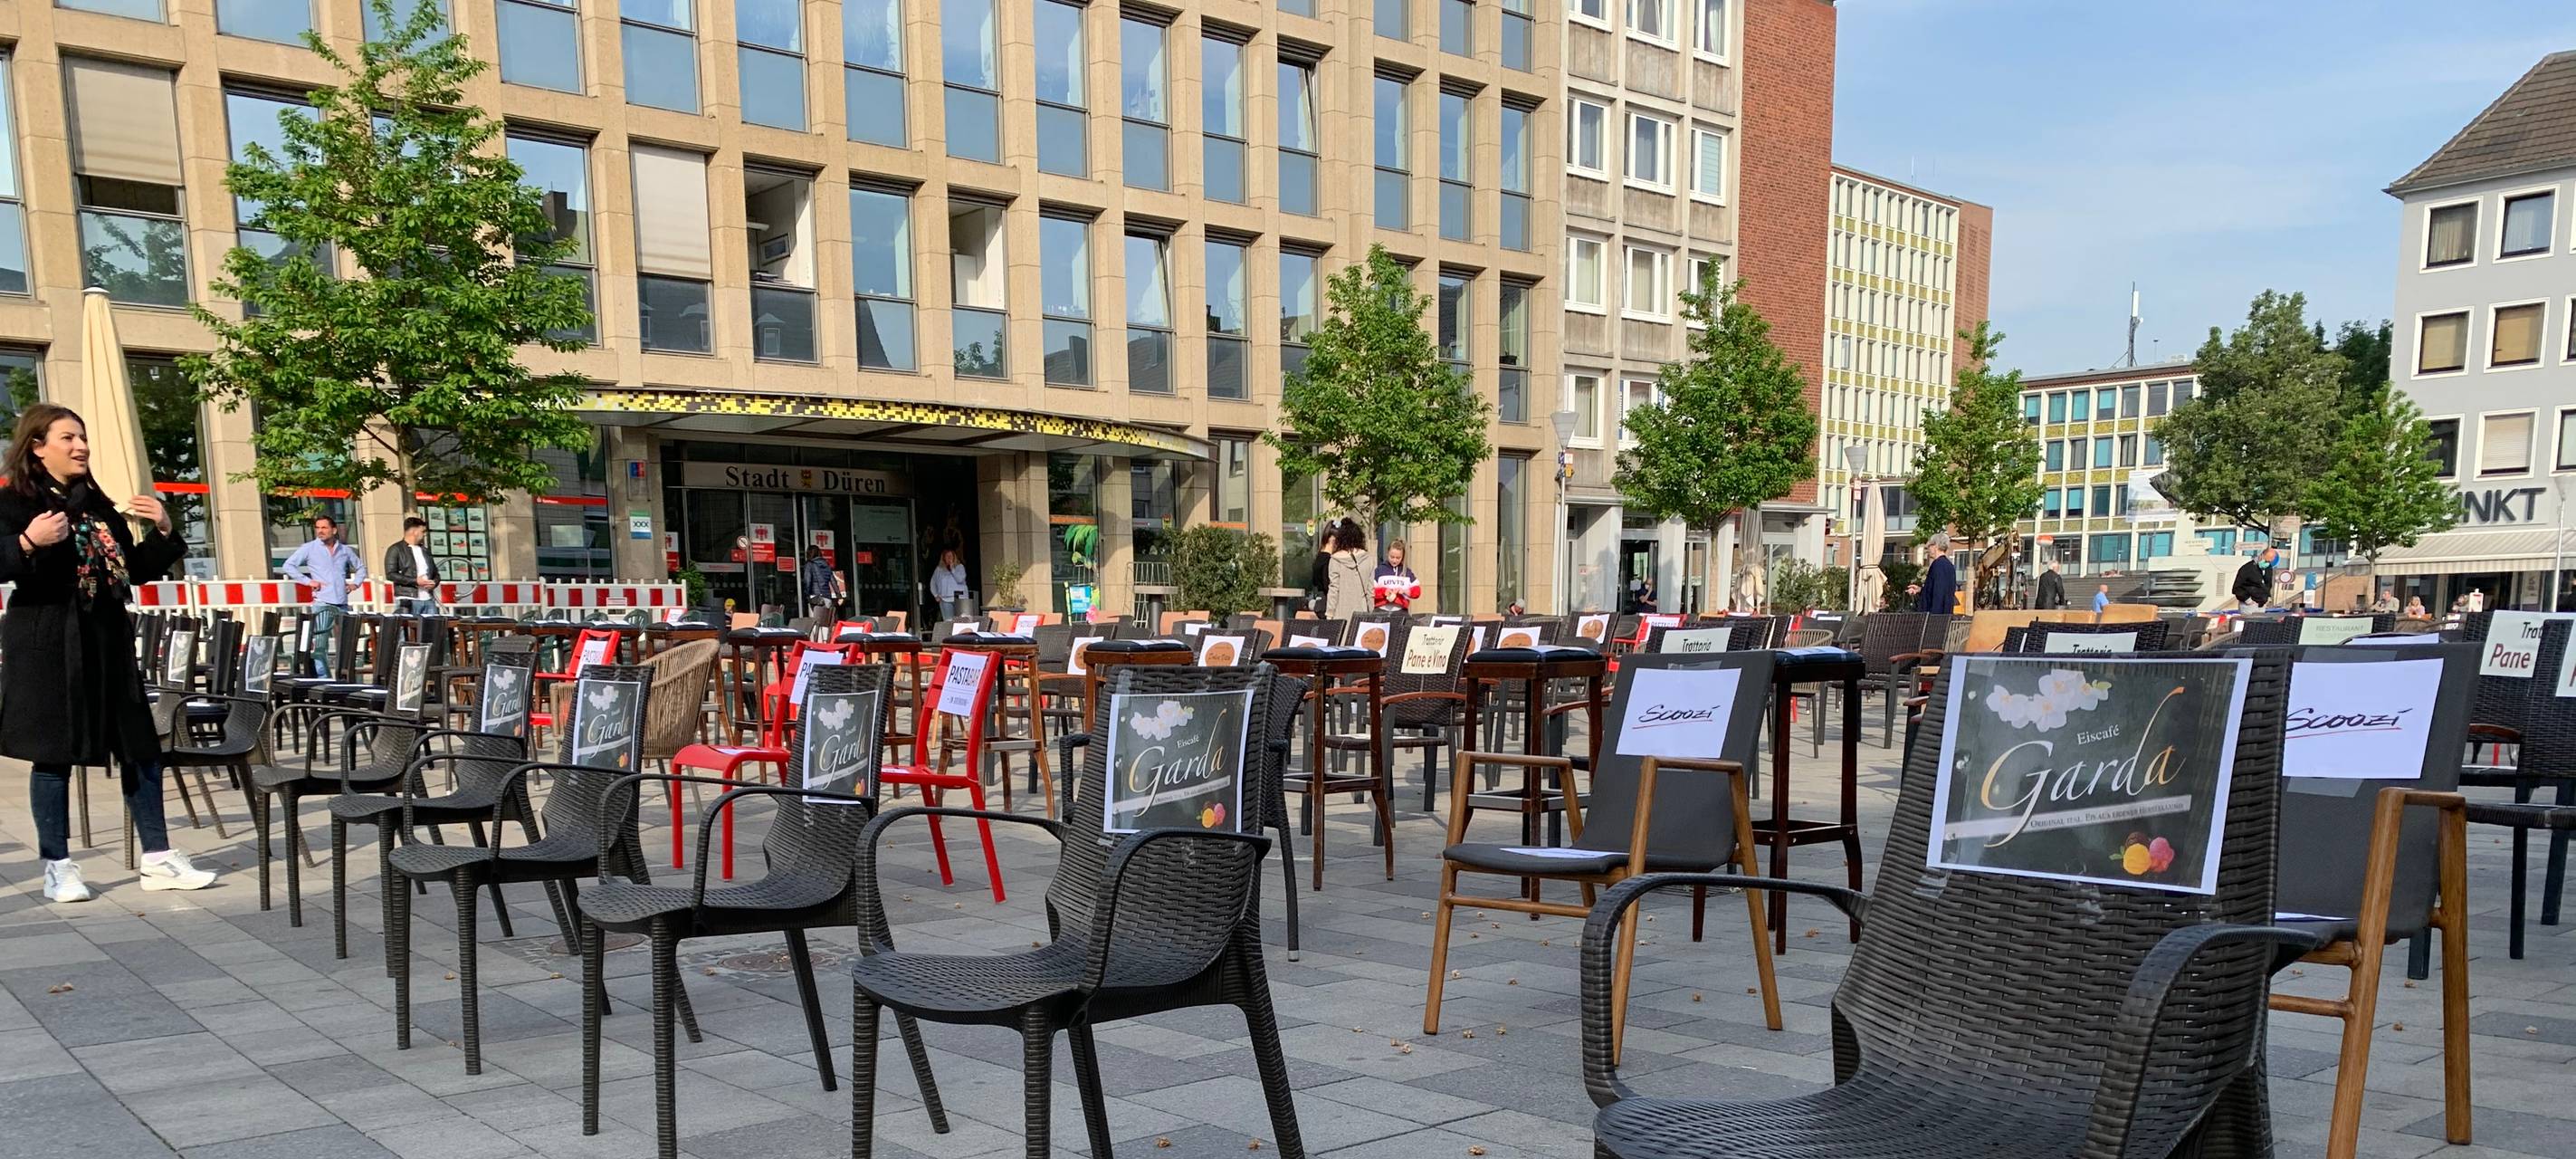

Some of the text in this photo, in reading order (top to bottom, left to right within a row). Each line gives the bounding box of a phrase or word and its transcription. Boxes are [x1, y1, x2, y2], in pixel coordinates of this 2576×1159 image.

[725, 465, 886, 493] Stadt Düren
[2454, 487, 2547, 523] NKT
[1407, 649, 1426, 668] Pane
[1433, 649, 1447, 668] Vino
[2489, 643, 2532, 669] Pane
[2076, 723, 2121, 746] Eiscafé
[1129, 708, 1228, 819] Garda
[1980, 686, 2187, 848] Garda
